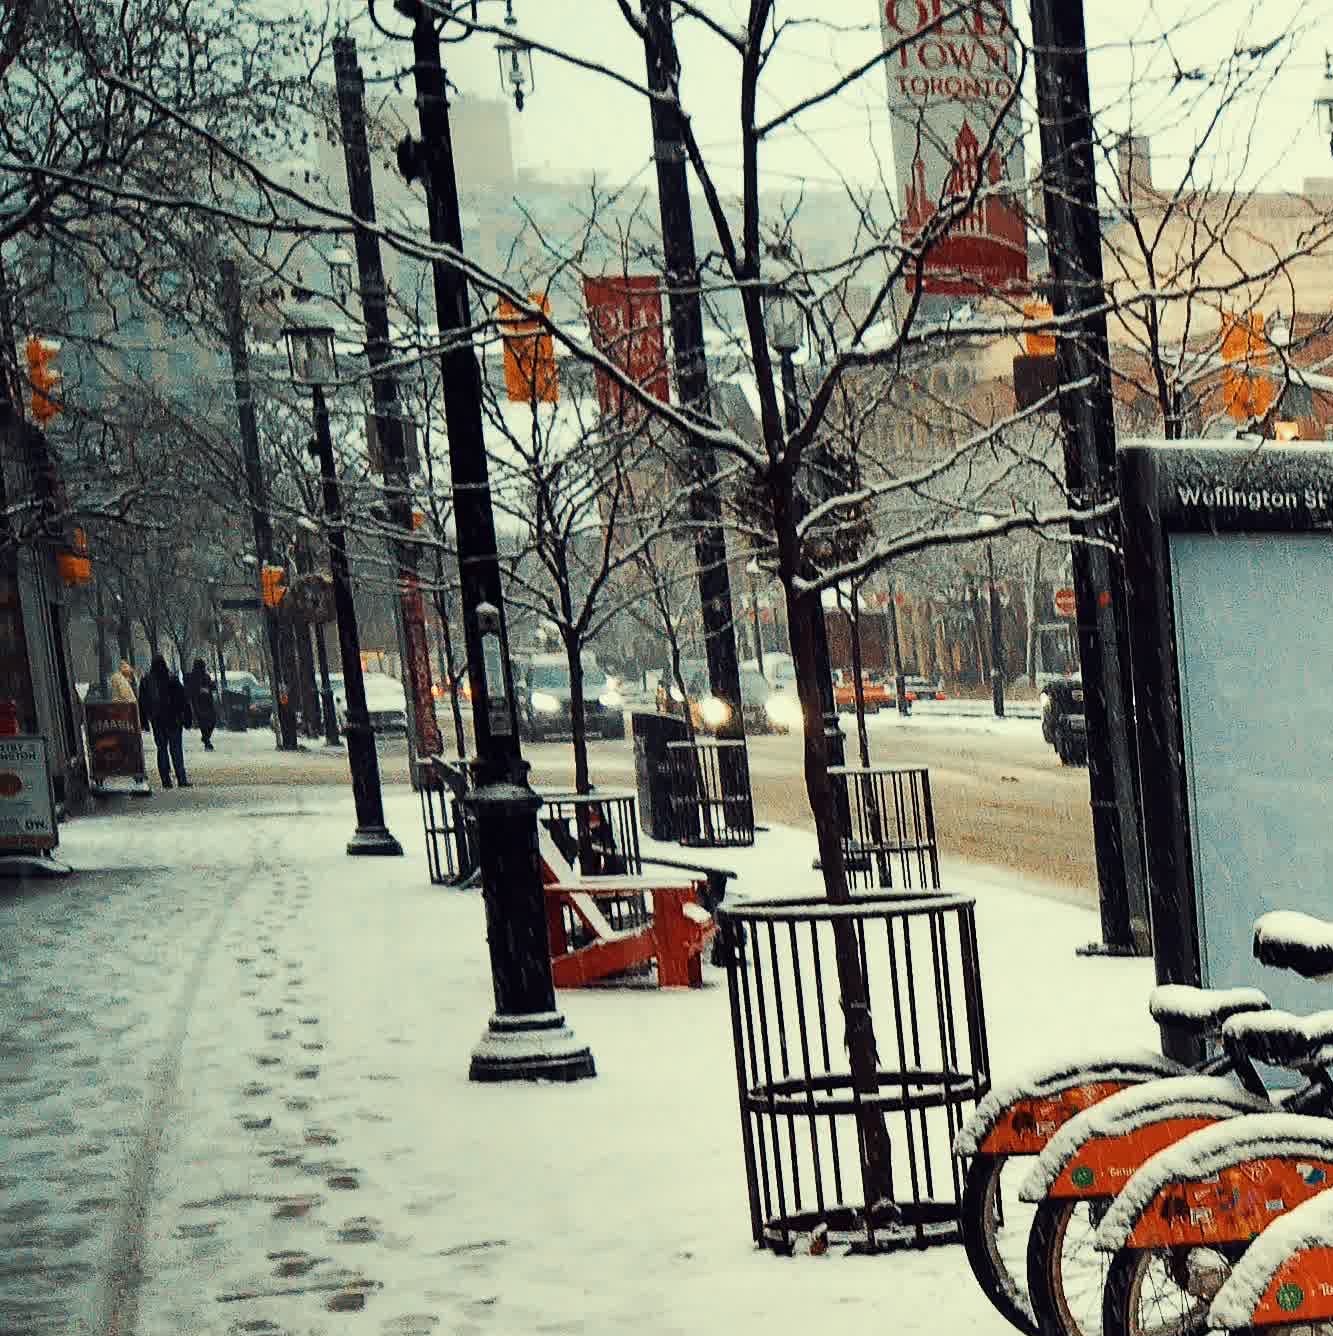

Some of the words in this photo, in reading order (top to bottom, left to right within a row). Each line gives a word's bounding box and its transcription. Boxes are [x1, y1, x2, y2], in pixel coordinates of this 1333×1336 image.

[898, 41, 1009, 74] TOWN
[897, 76, 1012, 98] TORONTO
[1305, 487, 1326, 510] St
